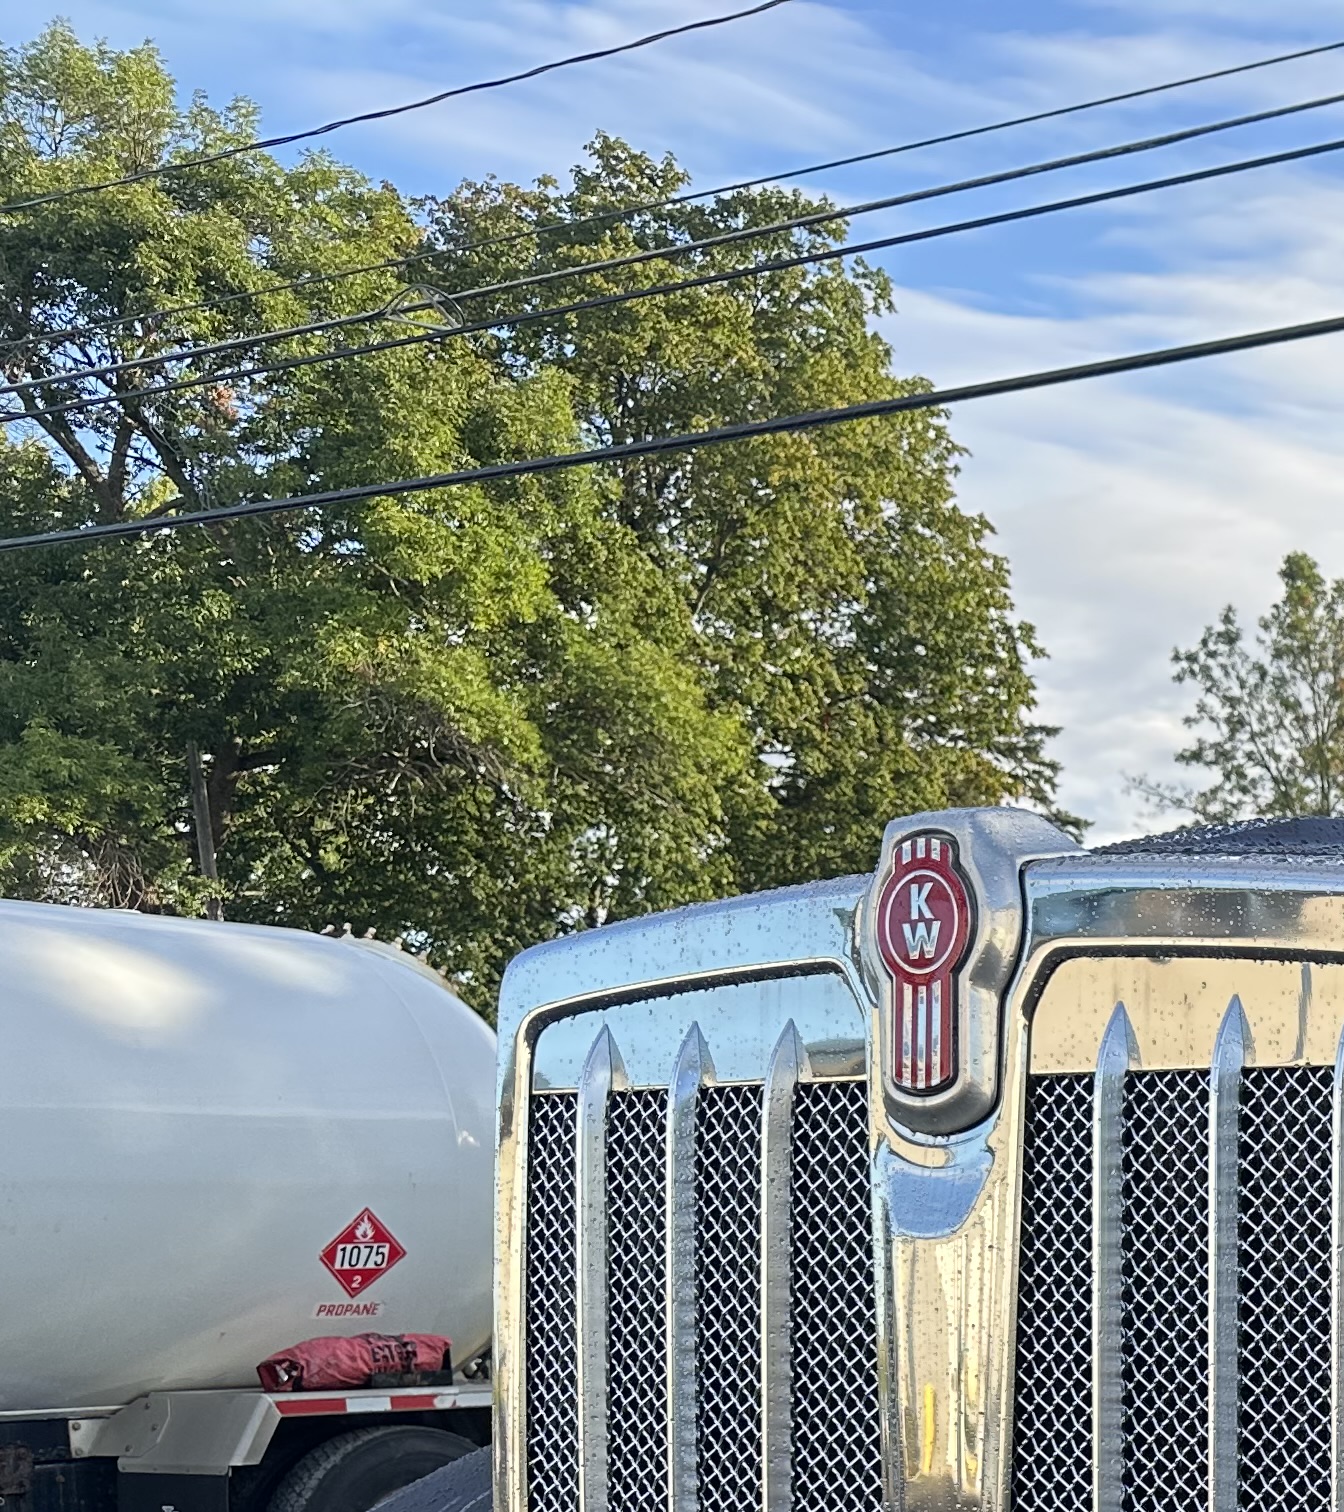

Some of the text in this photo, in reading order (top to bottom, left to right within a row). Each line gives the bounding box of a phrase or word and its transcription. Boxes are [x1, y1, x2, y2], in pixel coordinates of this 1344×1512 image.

[339, 1244, 387, 1268] 1075
[350, 1275, 362, 1288] 2
[315, 1301, 381, 1318] PROPANE
